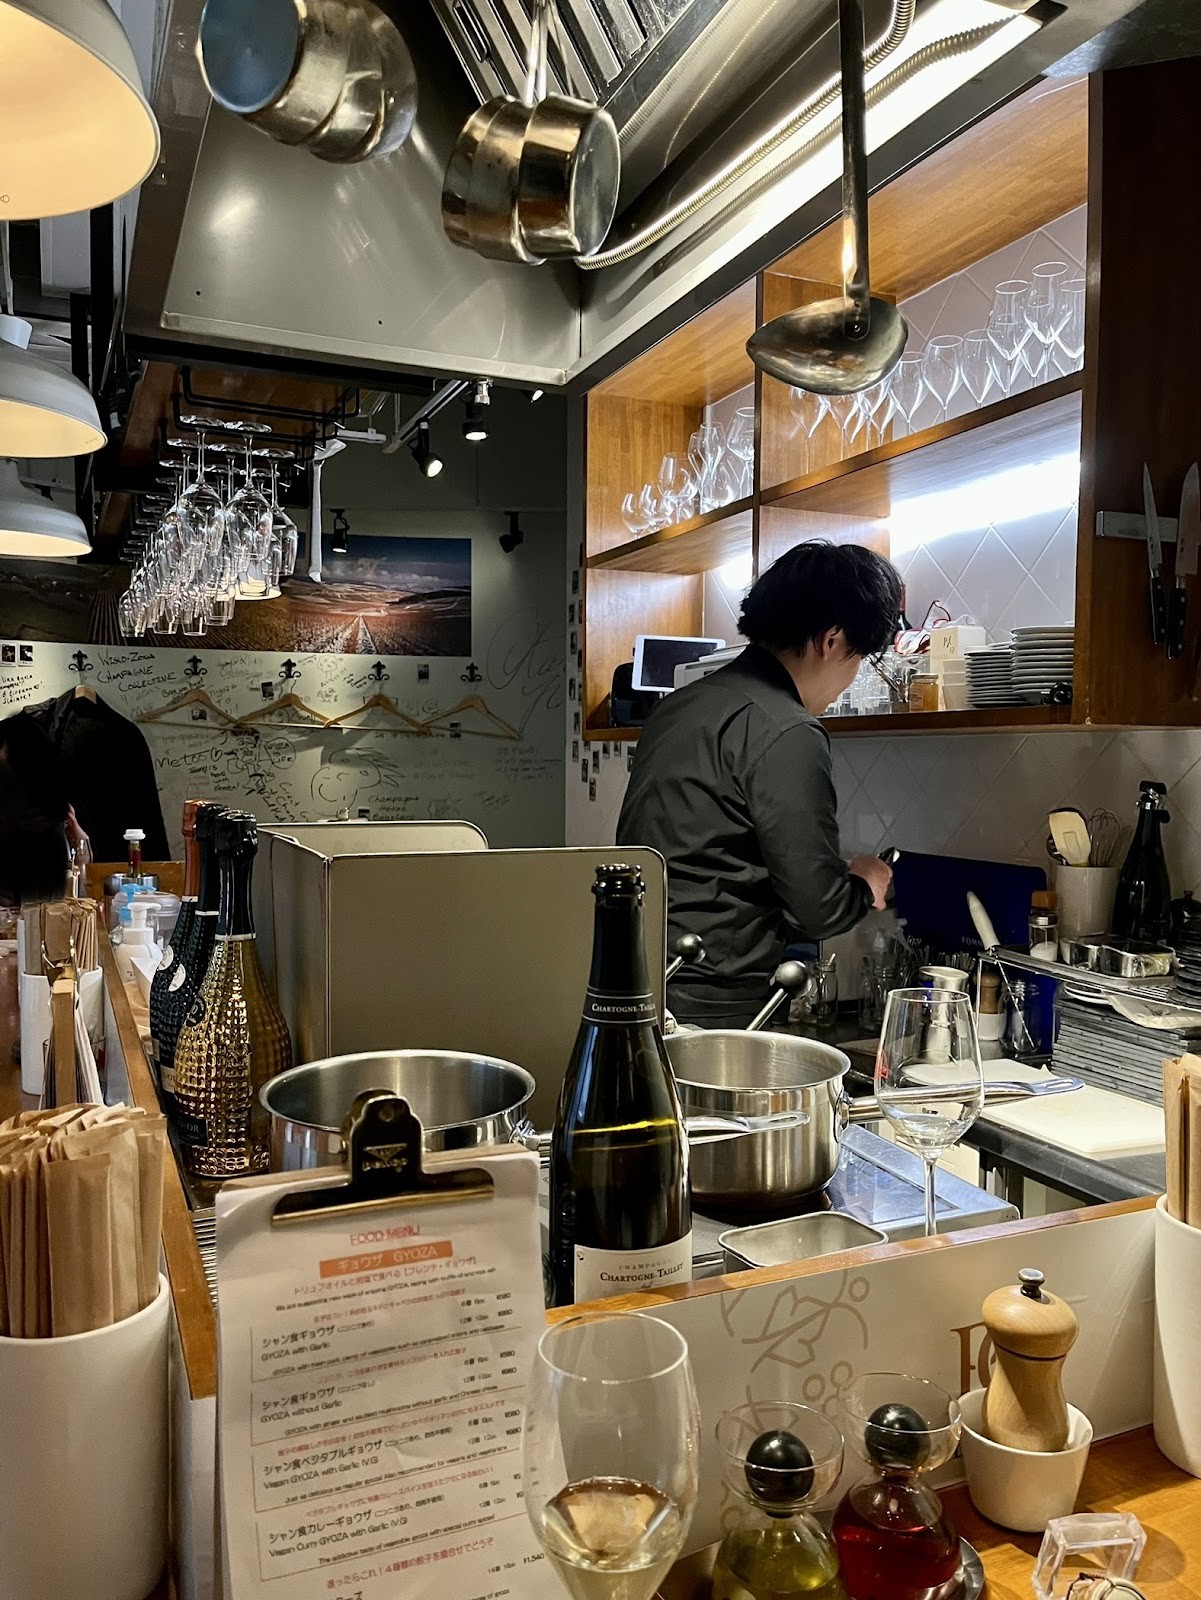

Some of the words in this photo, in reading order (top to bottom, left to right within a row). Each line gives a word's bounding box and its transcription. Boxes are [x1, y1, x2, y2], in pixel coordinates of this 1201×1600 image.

[97, 665, 153, 683] CHAMPAGNE
[119, 672, 177, 692] COLLECTIVE
[350, 1230, 384, 1246] FOOD
[337, 1253, 383, 1271] ギョウザ
[393, 1246, 438, 1262] GYOZA
[600, 1263, 683, 1282] CHARTOGNE-TAILLET
[261, 1350, 290, 1361] GYOZA
[292, 1347, 308, 1355] with
[261, 1411, 290, 1423] GYOZA
[292, 1405, 319, 1417] without
[321, 1400, 342, 1410] Garlic
[290, 1471, 319, 1483] GYOZA
[321, 1467, 338, 1476] with
[338, 1461, 360, 1471] Garlic
[296, 1541, 318, 1551] Curry
[319, 1532, 349, 1545] GYOZA
[350, 1528, 367, 1538] with
[368, 1522, 390, 1533] Garlic
